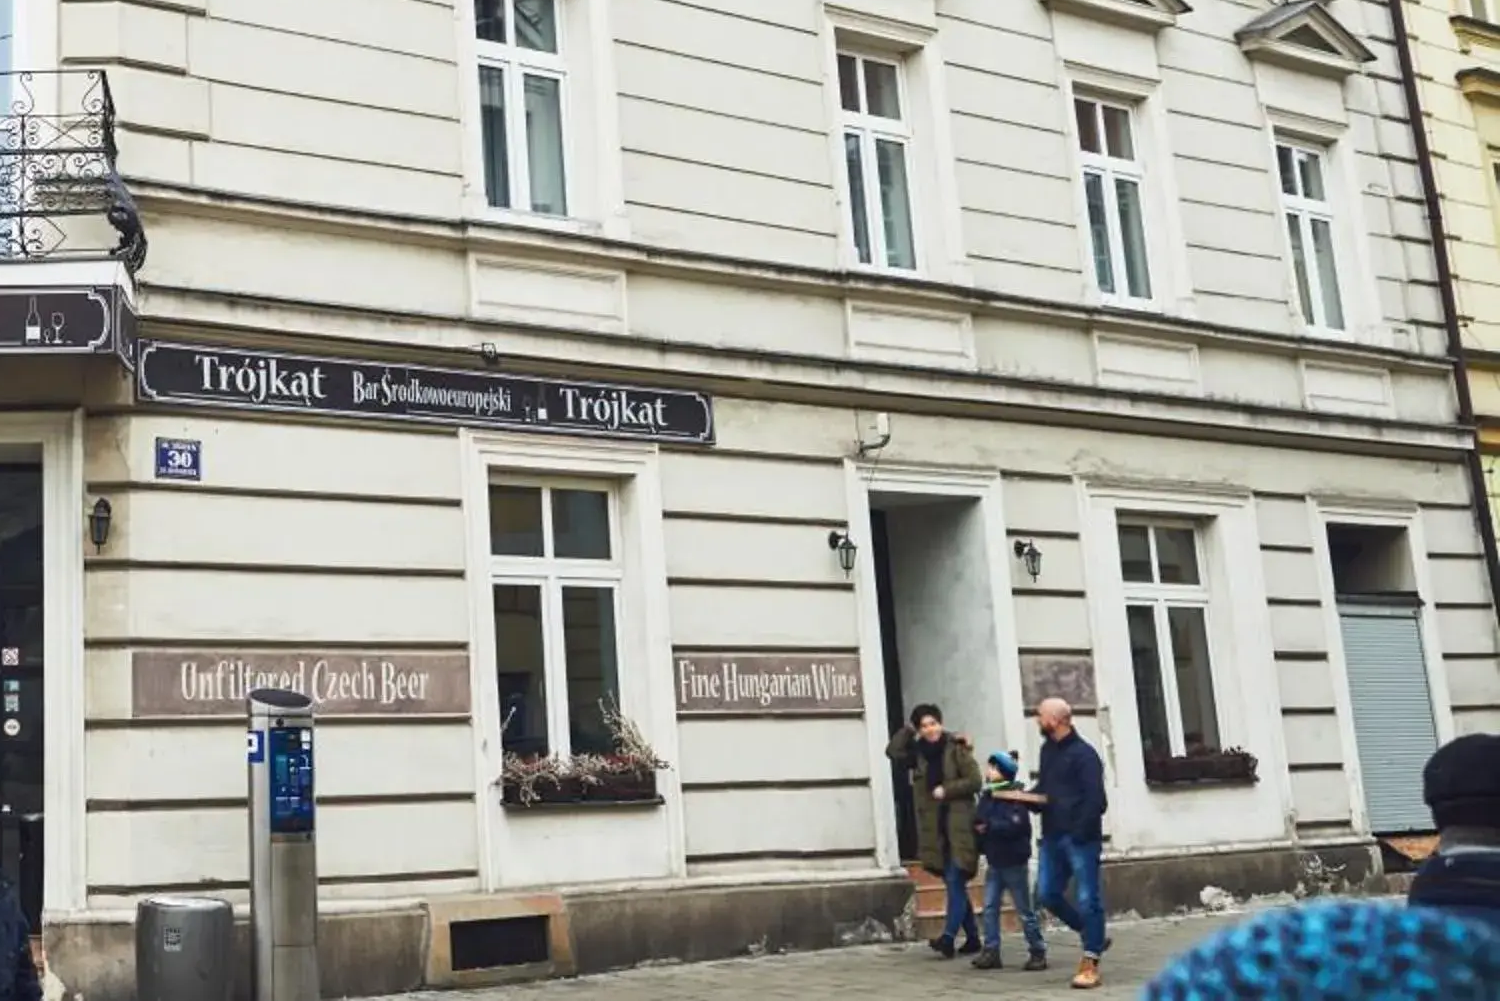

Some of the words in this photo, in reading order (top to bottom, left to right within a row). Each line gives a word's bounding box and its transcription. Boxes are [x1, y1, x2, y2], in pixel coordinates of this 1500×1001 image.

[196, 355, 327, 407] Trójkąt
[352, 370, 379, 404] Bar
[381, 367, 512, 416] Środkowoeuropejski
[560, 387, 668, 434] Trójkąt
[167, 449, 193, 468] 30
[180, 659, 305, 701] Unfiltered
[311, 659, 375, 704] Czech
[380, 659, 430, 704] Beer
[679, 659, 720, 704] Fine
[722, 662, 812, 706] Hungarian
[811, 662, 857, 701] Wine
